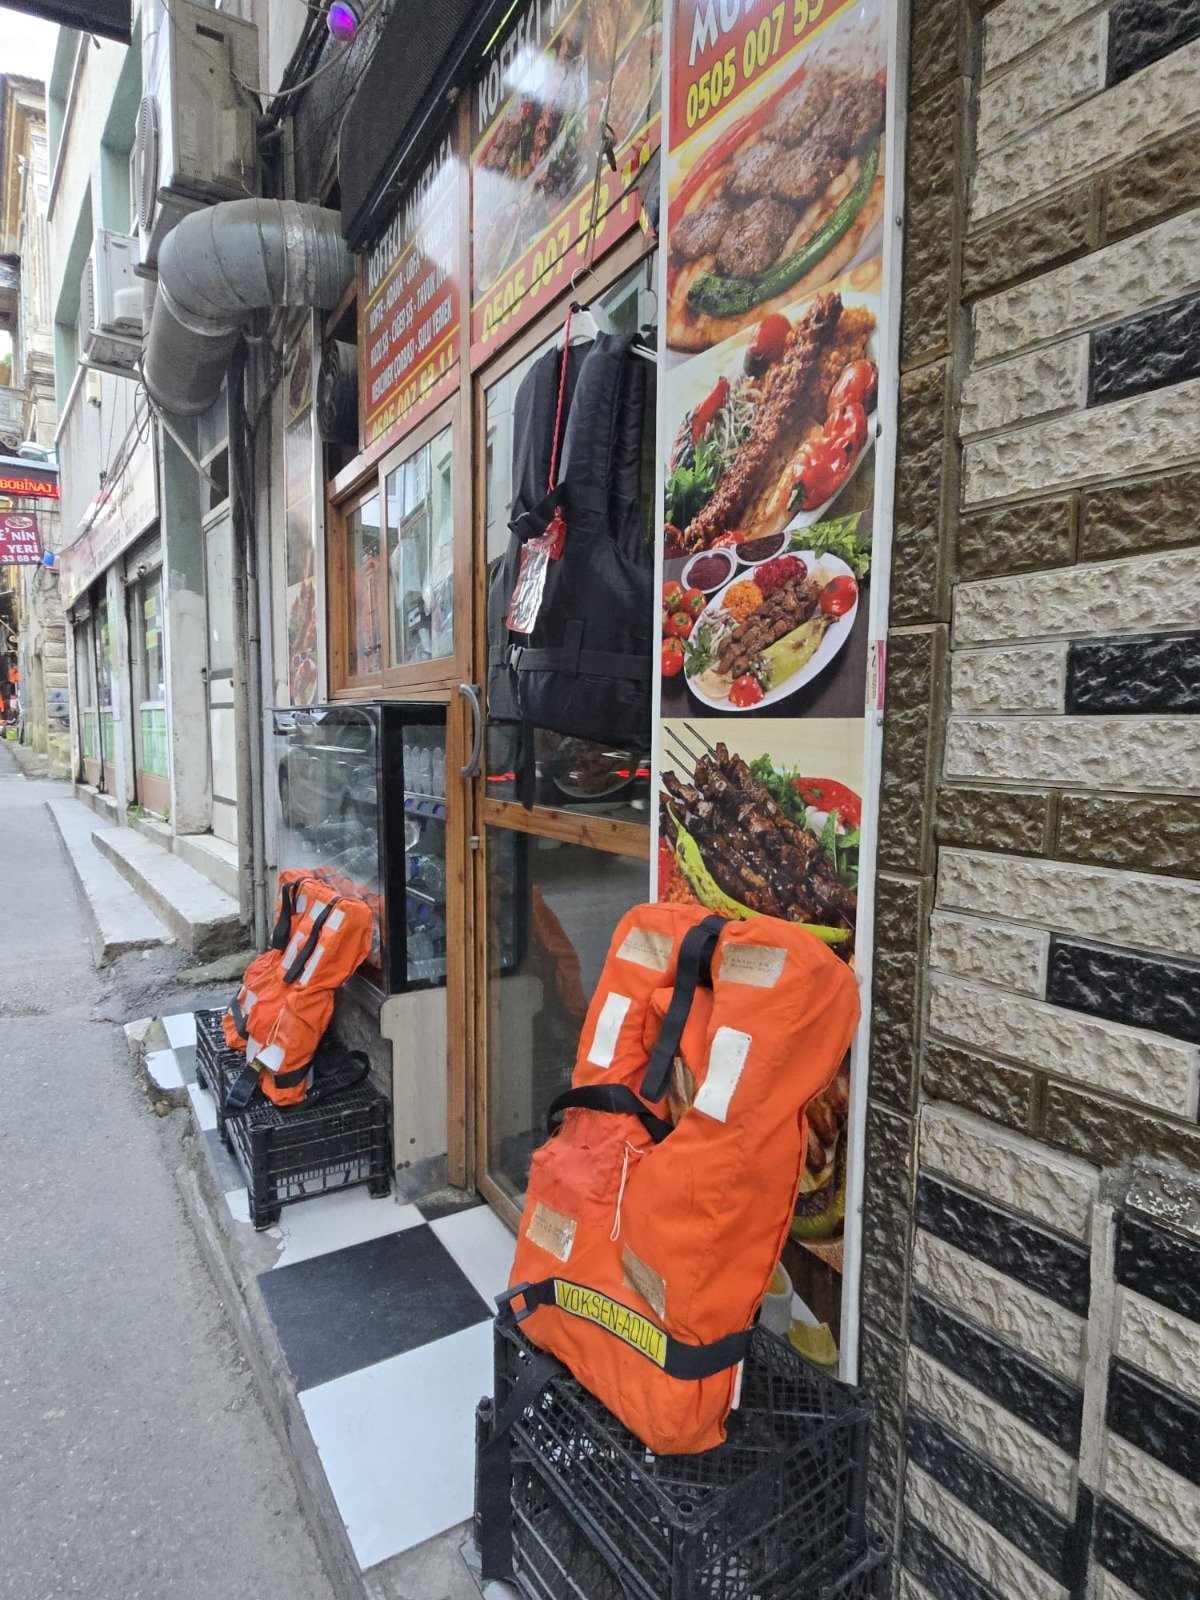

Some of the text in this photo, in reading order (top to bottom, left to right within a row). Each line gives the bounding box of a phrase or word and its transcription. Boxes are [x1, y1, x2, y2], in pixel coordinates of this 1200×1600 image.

[686, 46, 737, 128] 0505
[743, 0, 786, 79] 007
[481, 266, 526, 344] 0505
[530, 221, 571, 298] 007
[371, 403, 396, 450] 0505
[396, 380, 417, 426] 007
[7, 542, 39, 554] YERİ
[562, 1284, 663, 1358] VOKSEN-ADULT
